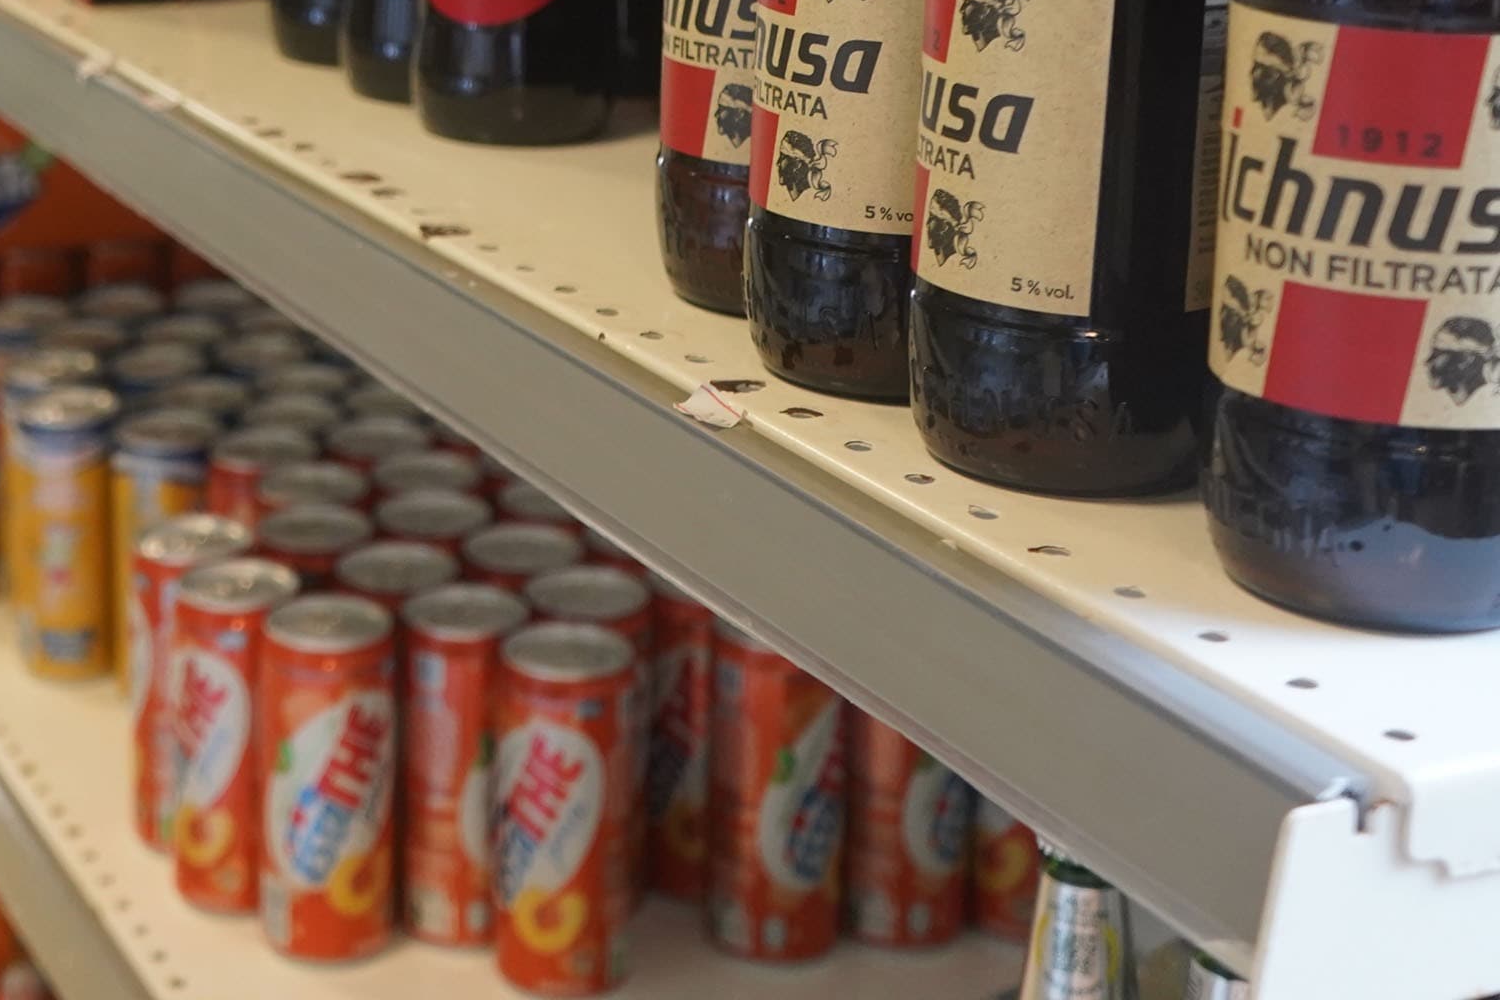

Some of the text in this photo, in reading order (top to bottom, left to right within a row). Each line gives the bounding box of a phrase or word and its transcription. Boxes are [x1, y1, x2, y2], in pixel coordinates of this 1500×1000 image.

[673, 36, 757, 70] FILTRAT
[1338, 124, 1443, 159] 1912
[865, 205, 875, 219] 5
[880, 207, 892, 221] %
[1245, 232, 1313, 277] NON
[1010, 276, 1075, 301] 5 % vol.
